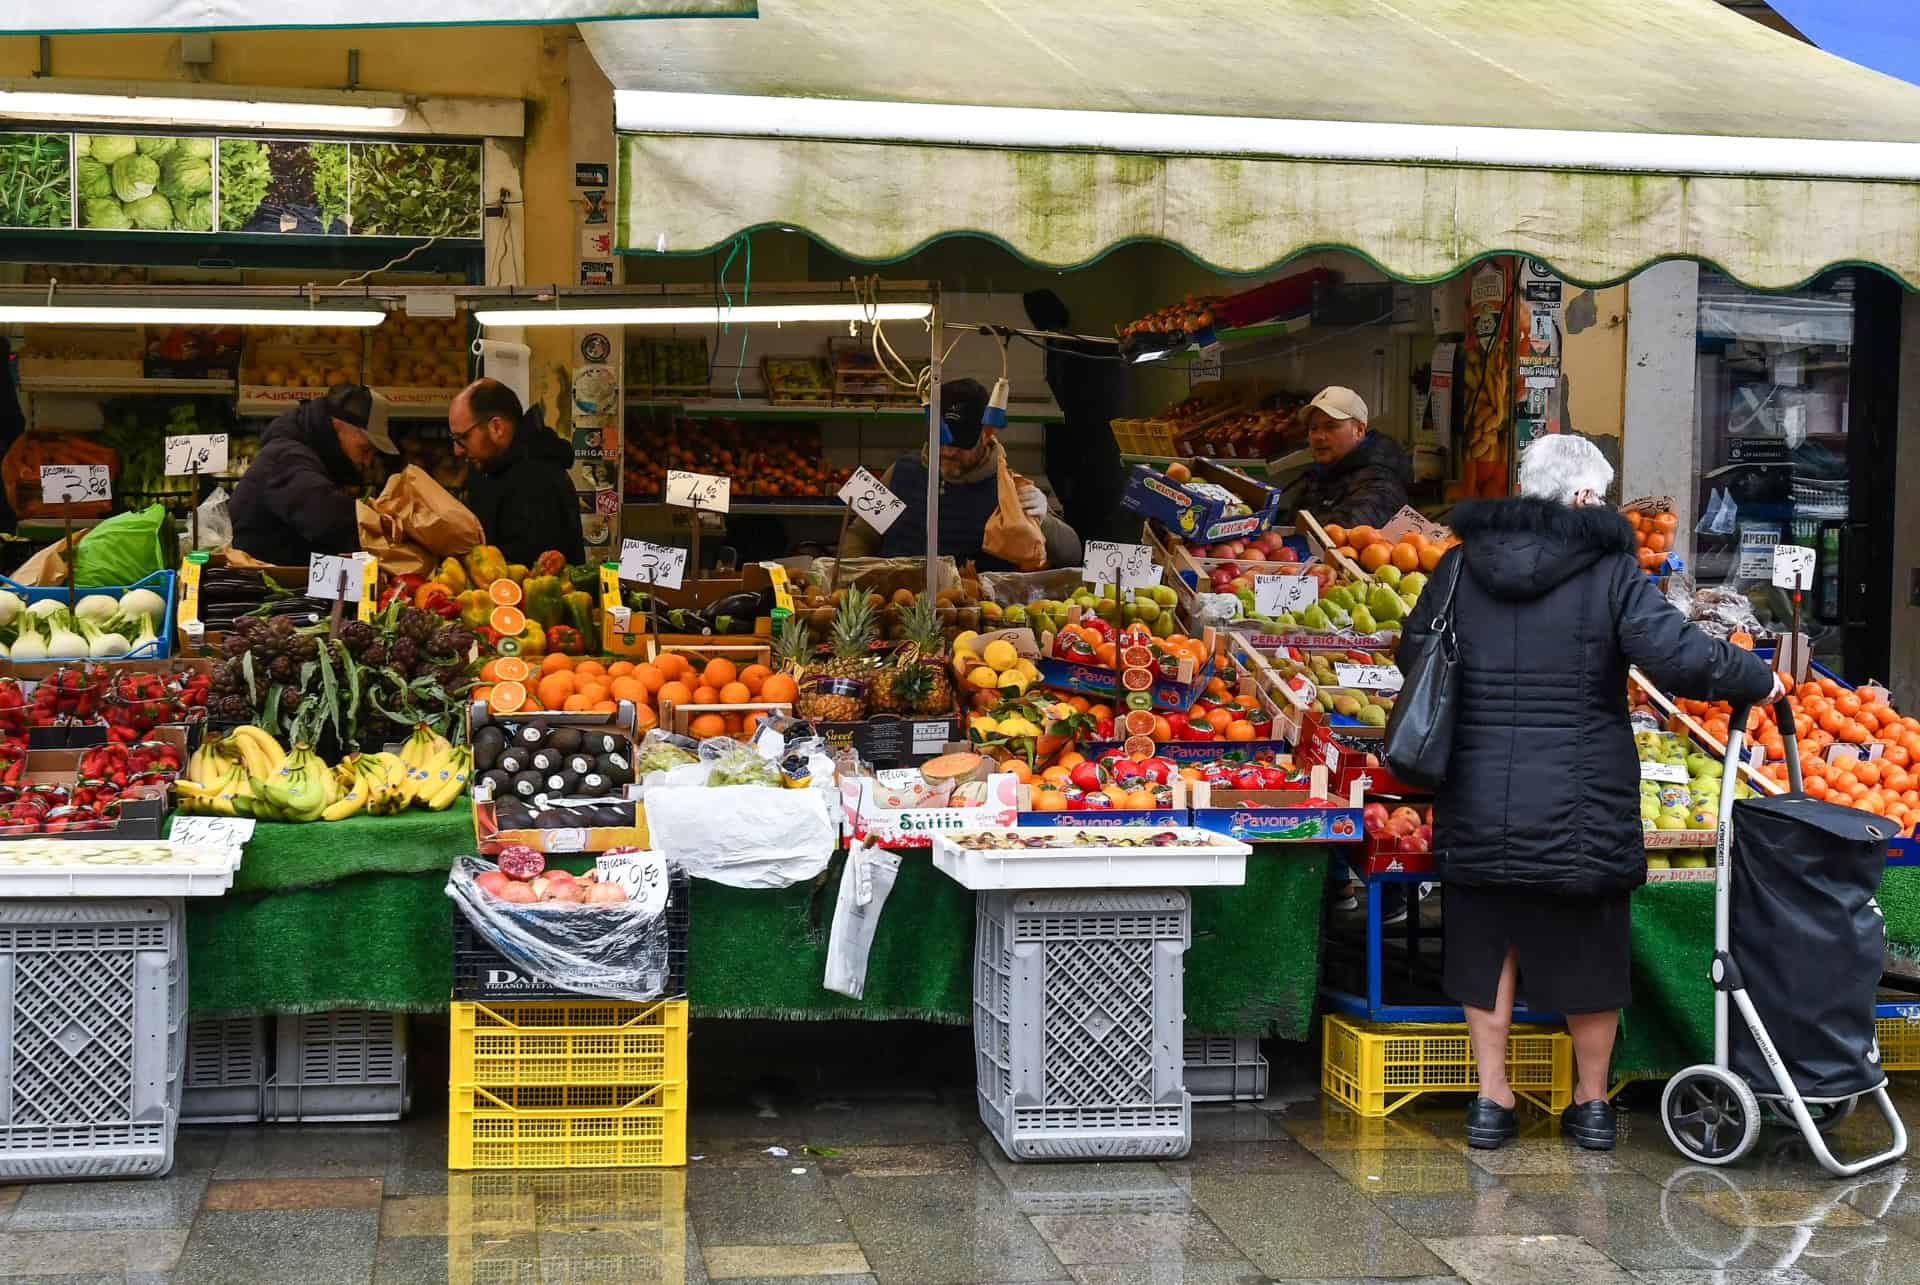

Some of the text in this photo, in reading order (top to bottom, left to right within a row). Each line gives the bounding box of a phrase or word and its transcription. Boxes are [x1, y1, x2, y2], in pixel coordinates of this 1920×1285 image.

[1743, 533, 1778, 545] APERTO
[1251, 634, 1290, 645] PERAS
[1294, 634, 1309, 645] DE
[1312, 634, 1336, 645] RIO
[900, 812, 964, 831] Sattin
[1239, 812, 1299, 827] Pavone
